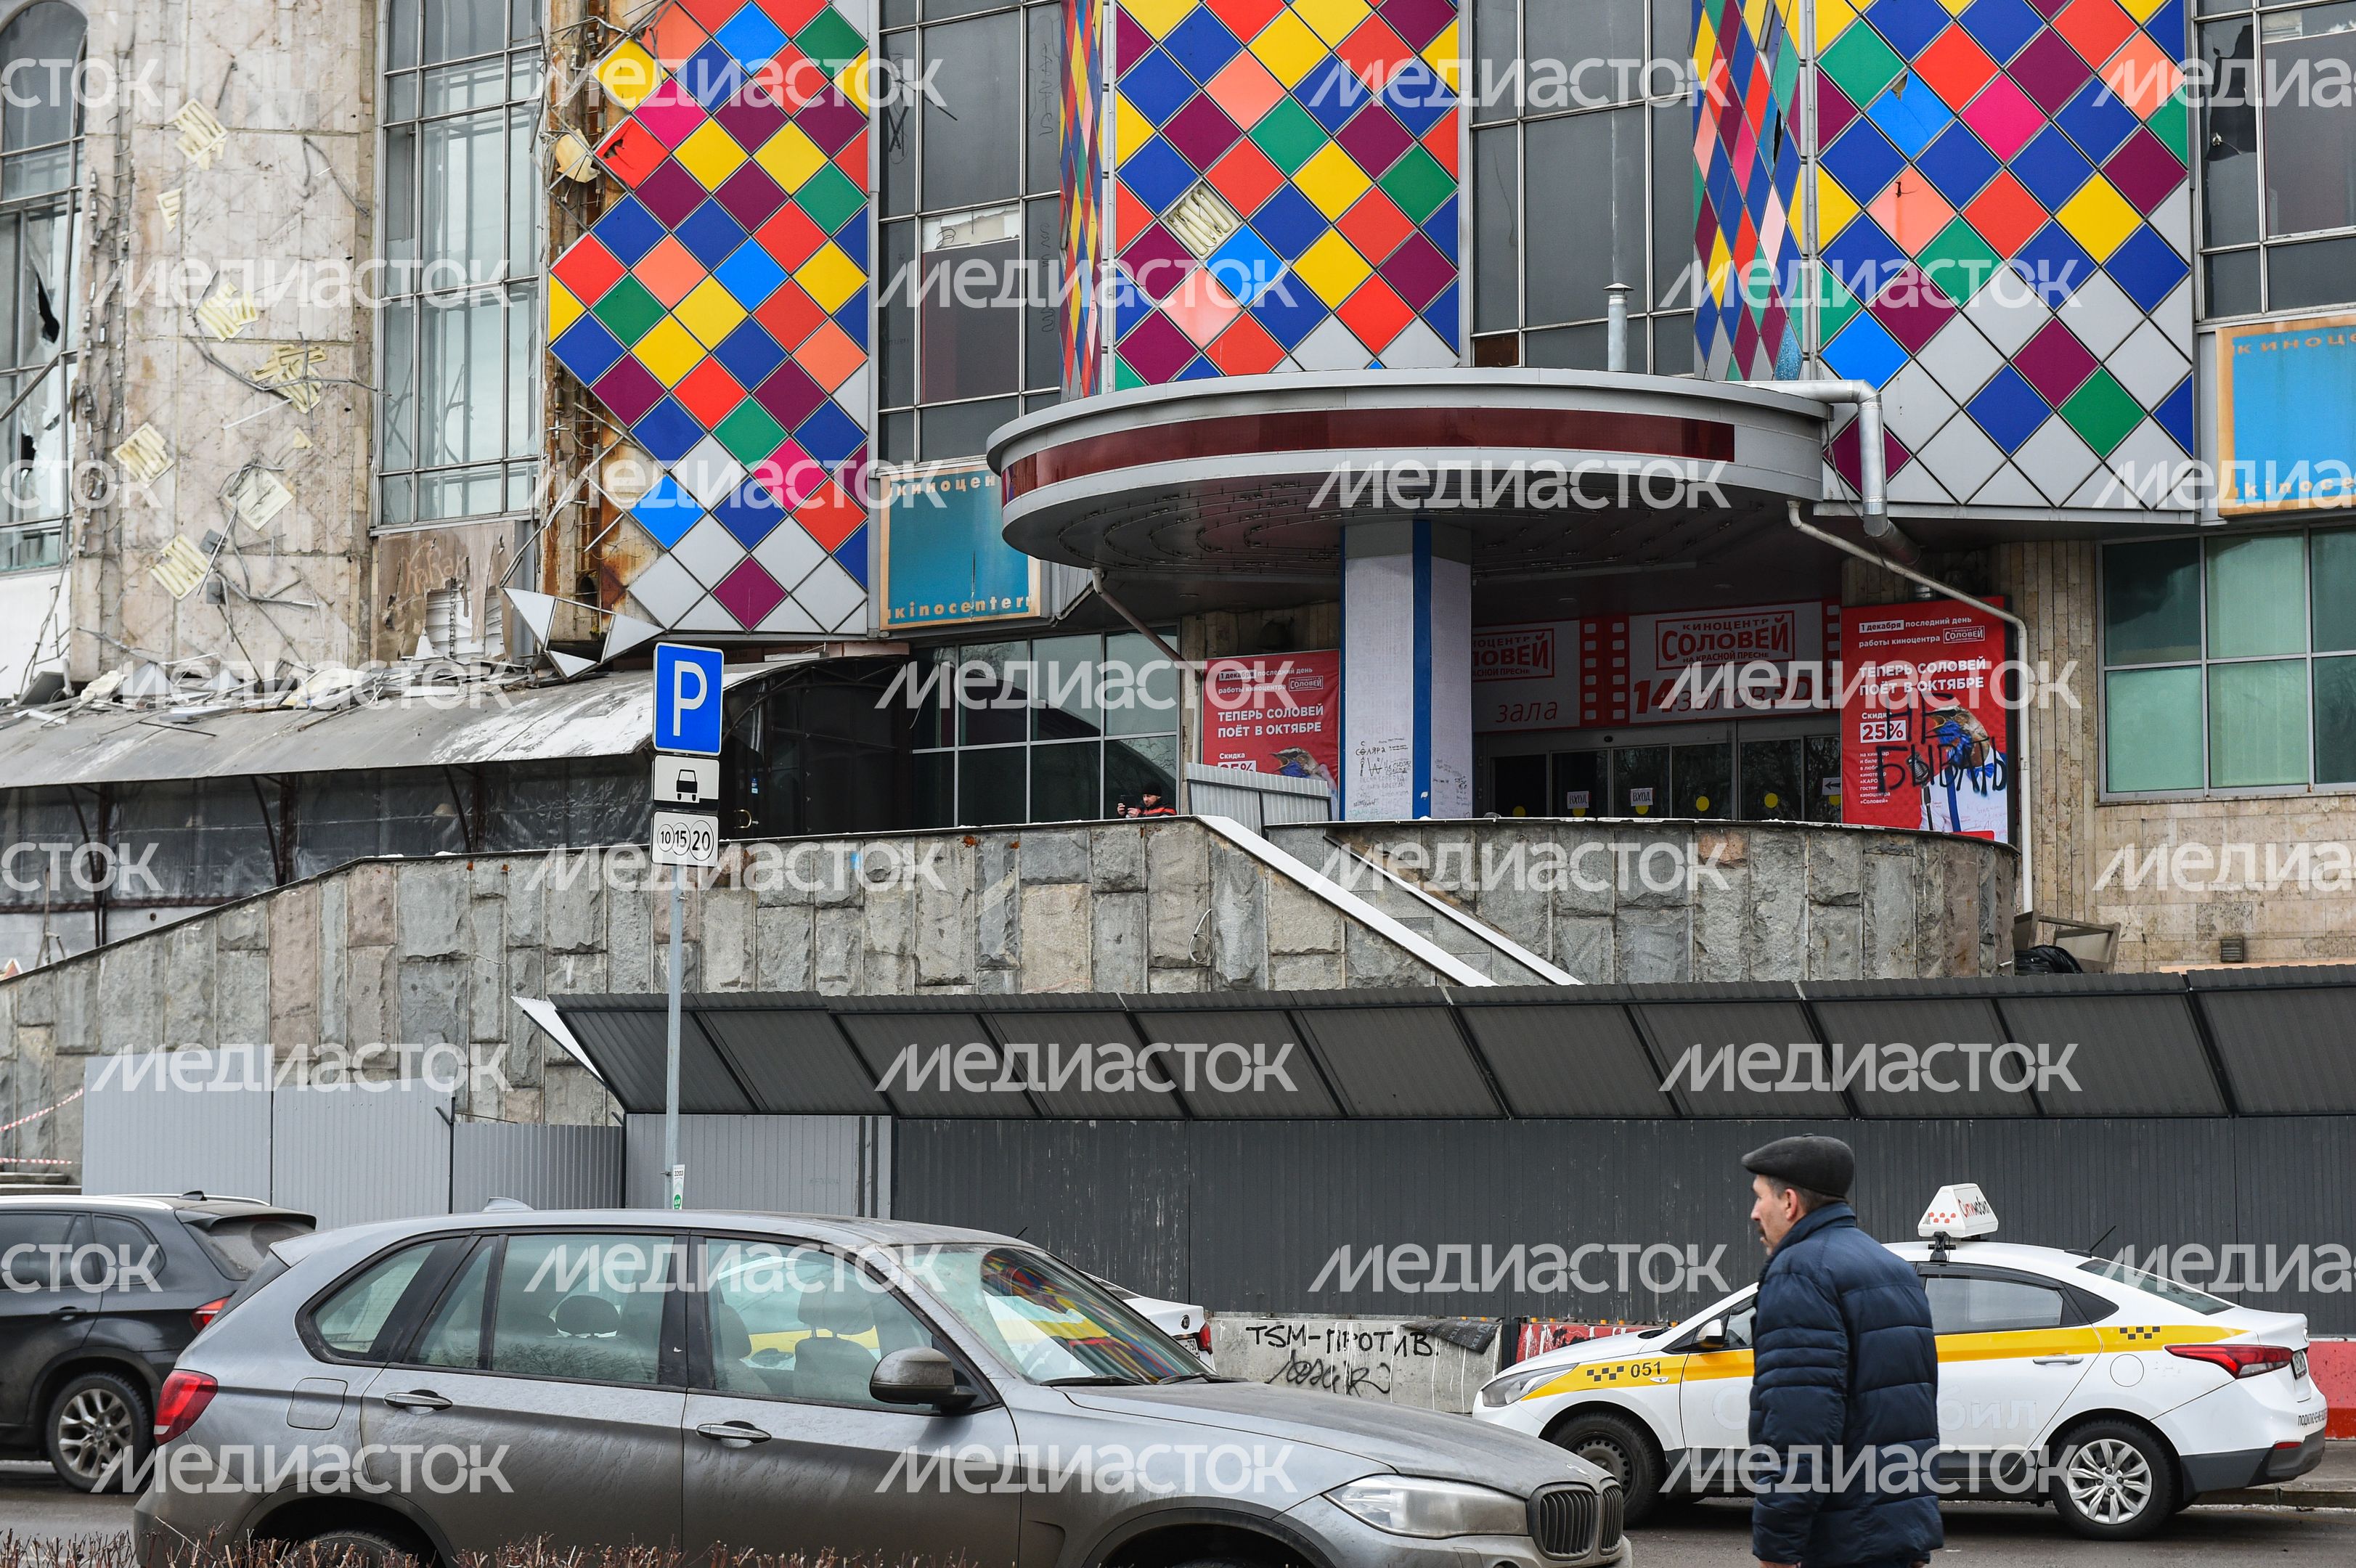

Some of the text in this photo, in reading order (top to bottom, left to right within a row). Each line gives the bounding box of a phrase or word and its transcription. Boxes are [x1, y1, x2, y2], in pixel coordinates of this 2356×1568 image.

[1683, 618, 1769, 631] КИНОЦЕНТР
[1867, 622, 1901, 632] декабря
[1906, 618, 1950, 627] последний
[1661, 614, 1788, 661] СОЛОВЕЙ
[1859, 636, 1940, 648] работы киноцентра
[1945, 626, 1984, 642] СОЛОВЕЙ
[1696, 650, 1736, 662] КРАСНОЙ
[1258, 668, 1295, 677] последний
[1859, 656, 1986, 678] ТЕПЕРЬ СОЛОВЕЙ
[1860, 677, 1984, 695] ПОЁТ В ОКТЯБРЕ
[673, 660, 707, 736] P
[1634, 678, 1678, 714] 14
[1678, 686, 1766, 712] залов
[1218, 703, 1324, 722] ТЕПЕРЬ СОЛОВЕЙ
[1496, 701, 1557, 723] зала
[1886, 691, 1954, 743] НЕ
[1218, 722, 1321, 738] ПОЁТ В ОКТЯБРЕ
[1863, 723, 1903, 740] 25%
[1633, 791, 1650, 801] ВХОД
[661, 830, 711, 852] 10 15 20
[1631, 1361, 1661, 1379] 051
